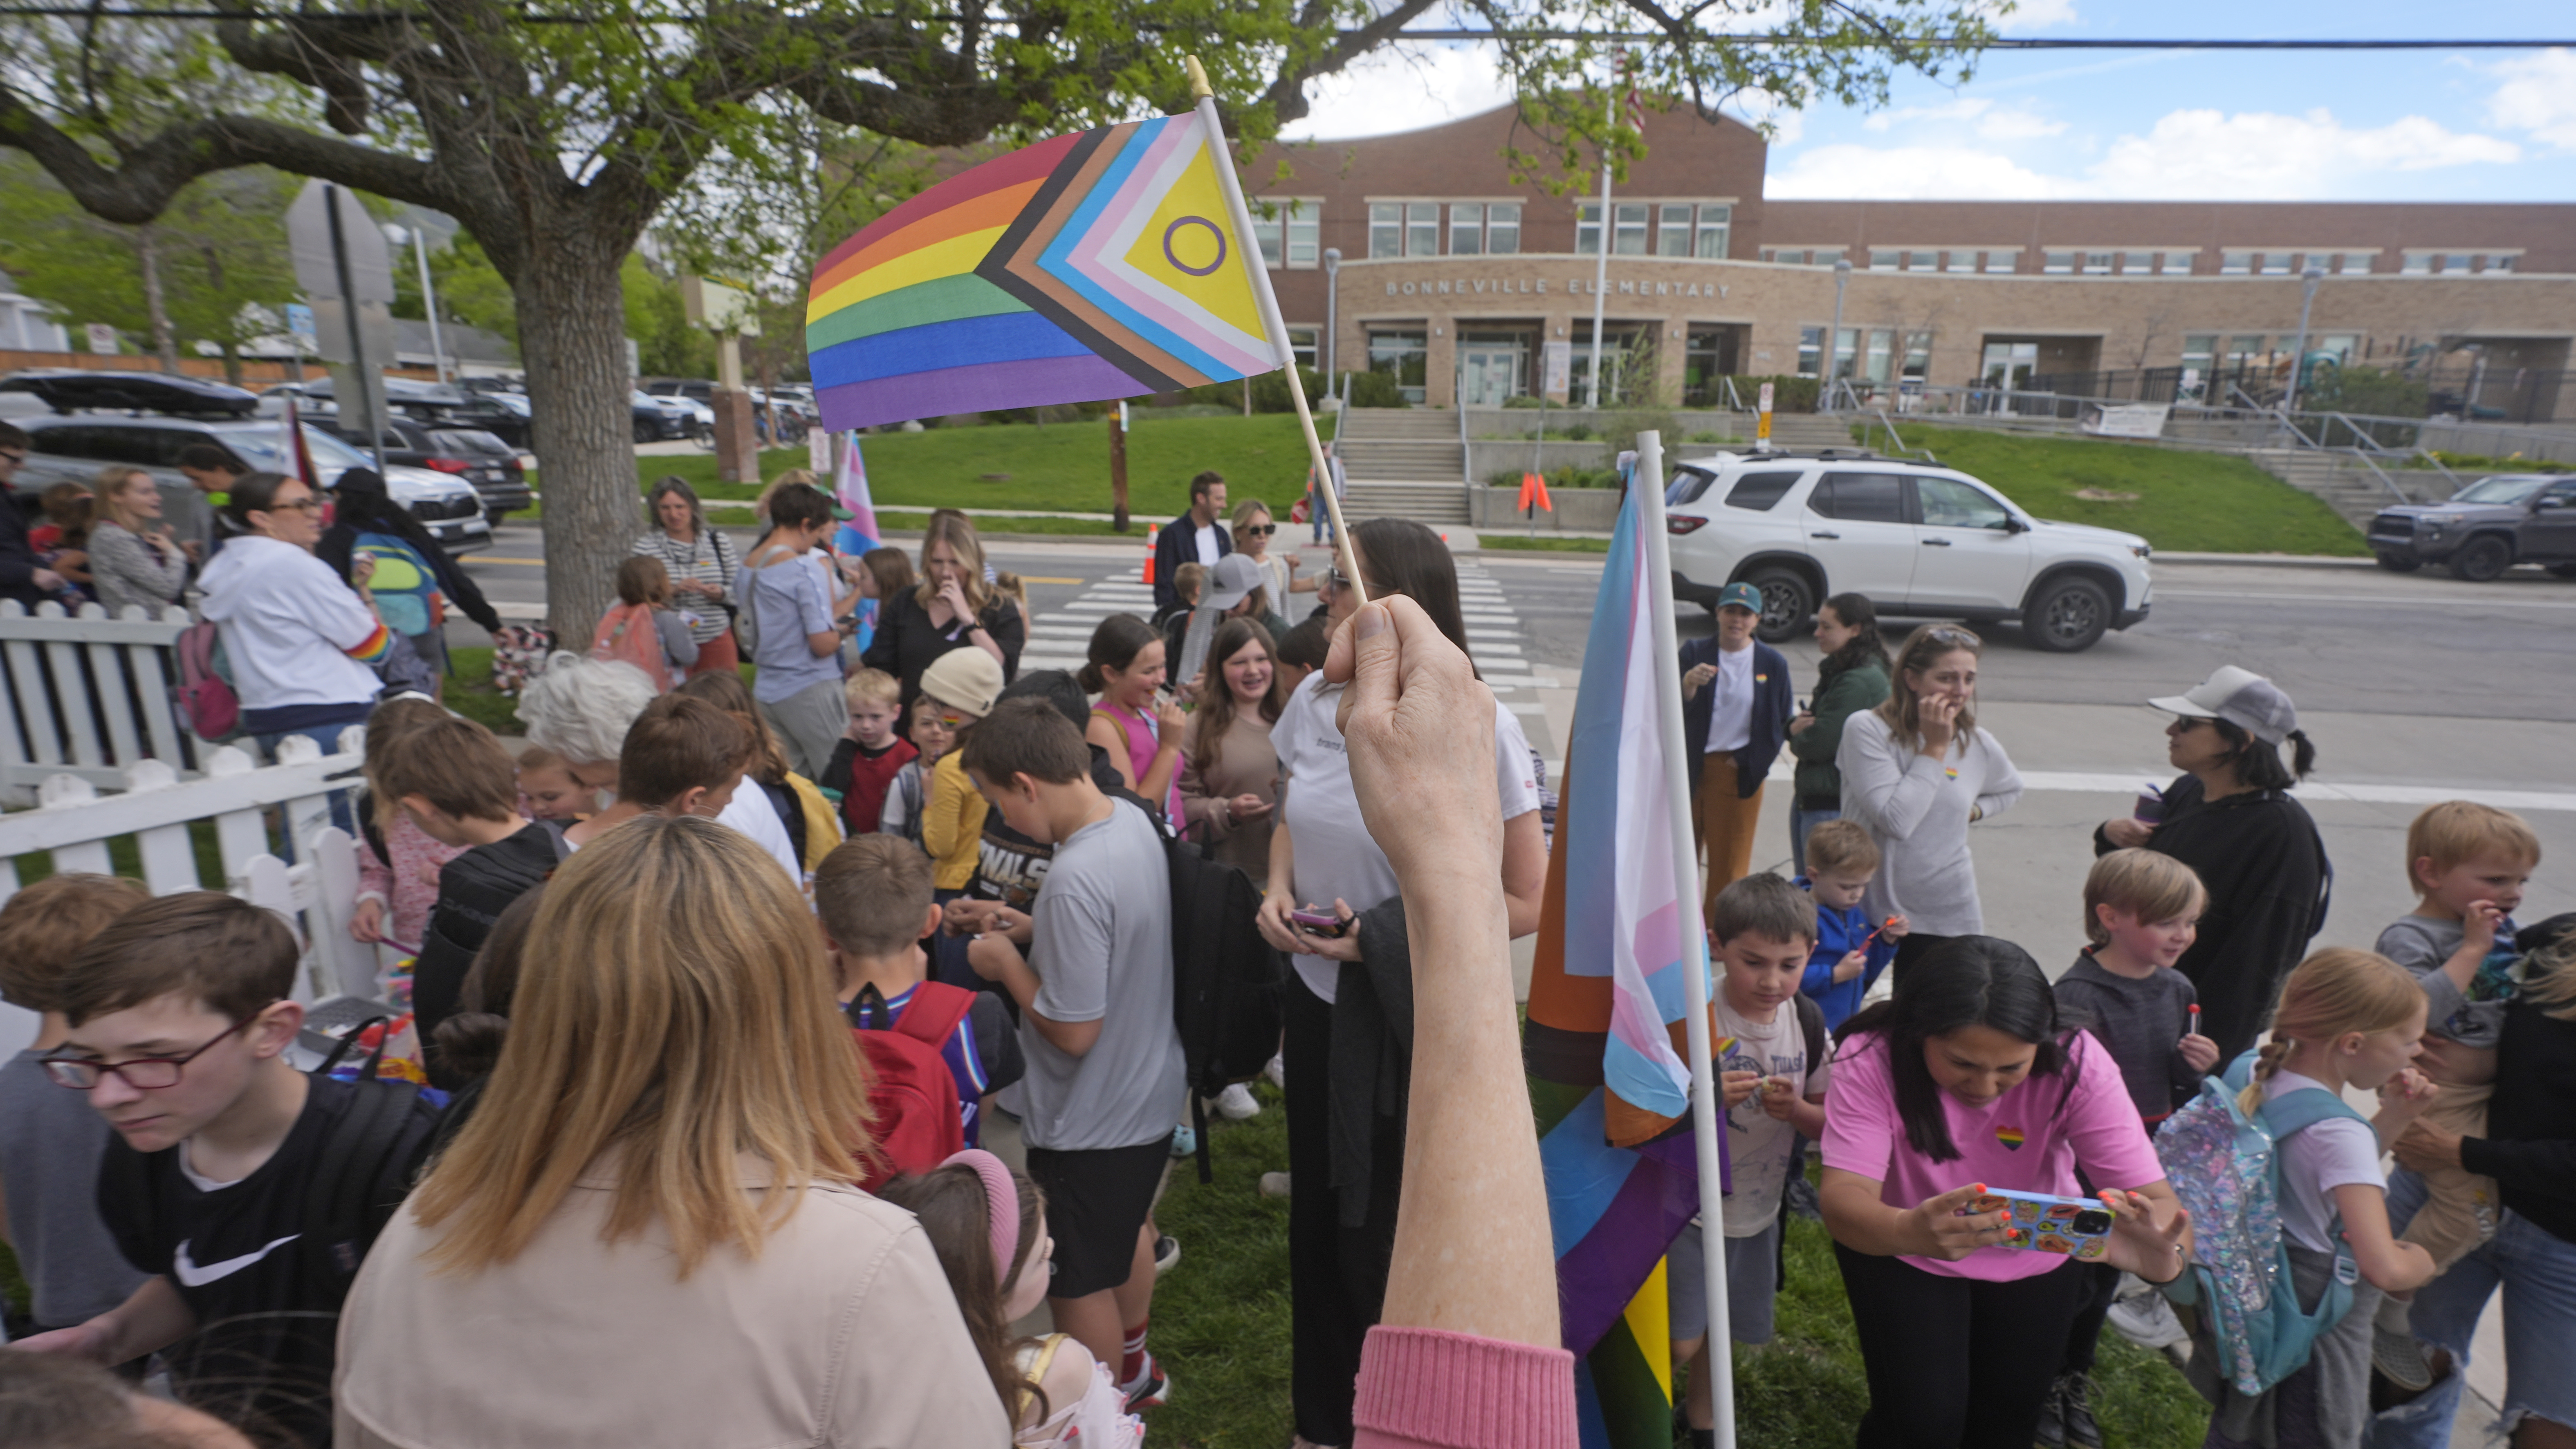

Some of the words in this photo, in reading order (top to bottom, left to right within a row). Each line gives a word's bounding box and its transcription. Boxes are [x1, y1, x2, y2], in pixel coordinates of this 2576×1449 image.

[1386, 278, 1548, 296] BONNEVILLE
[1568, 279, 1730, 299] ELEMENTARY
[1316, 738, 1342, 751] trans
